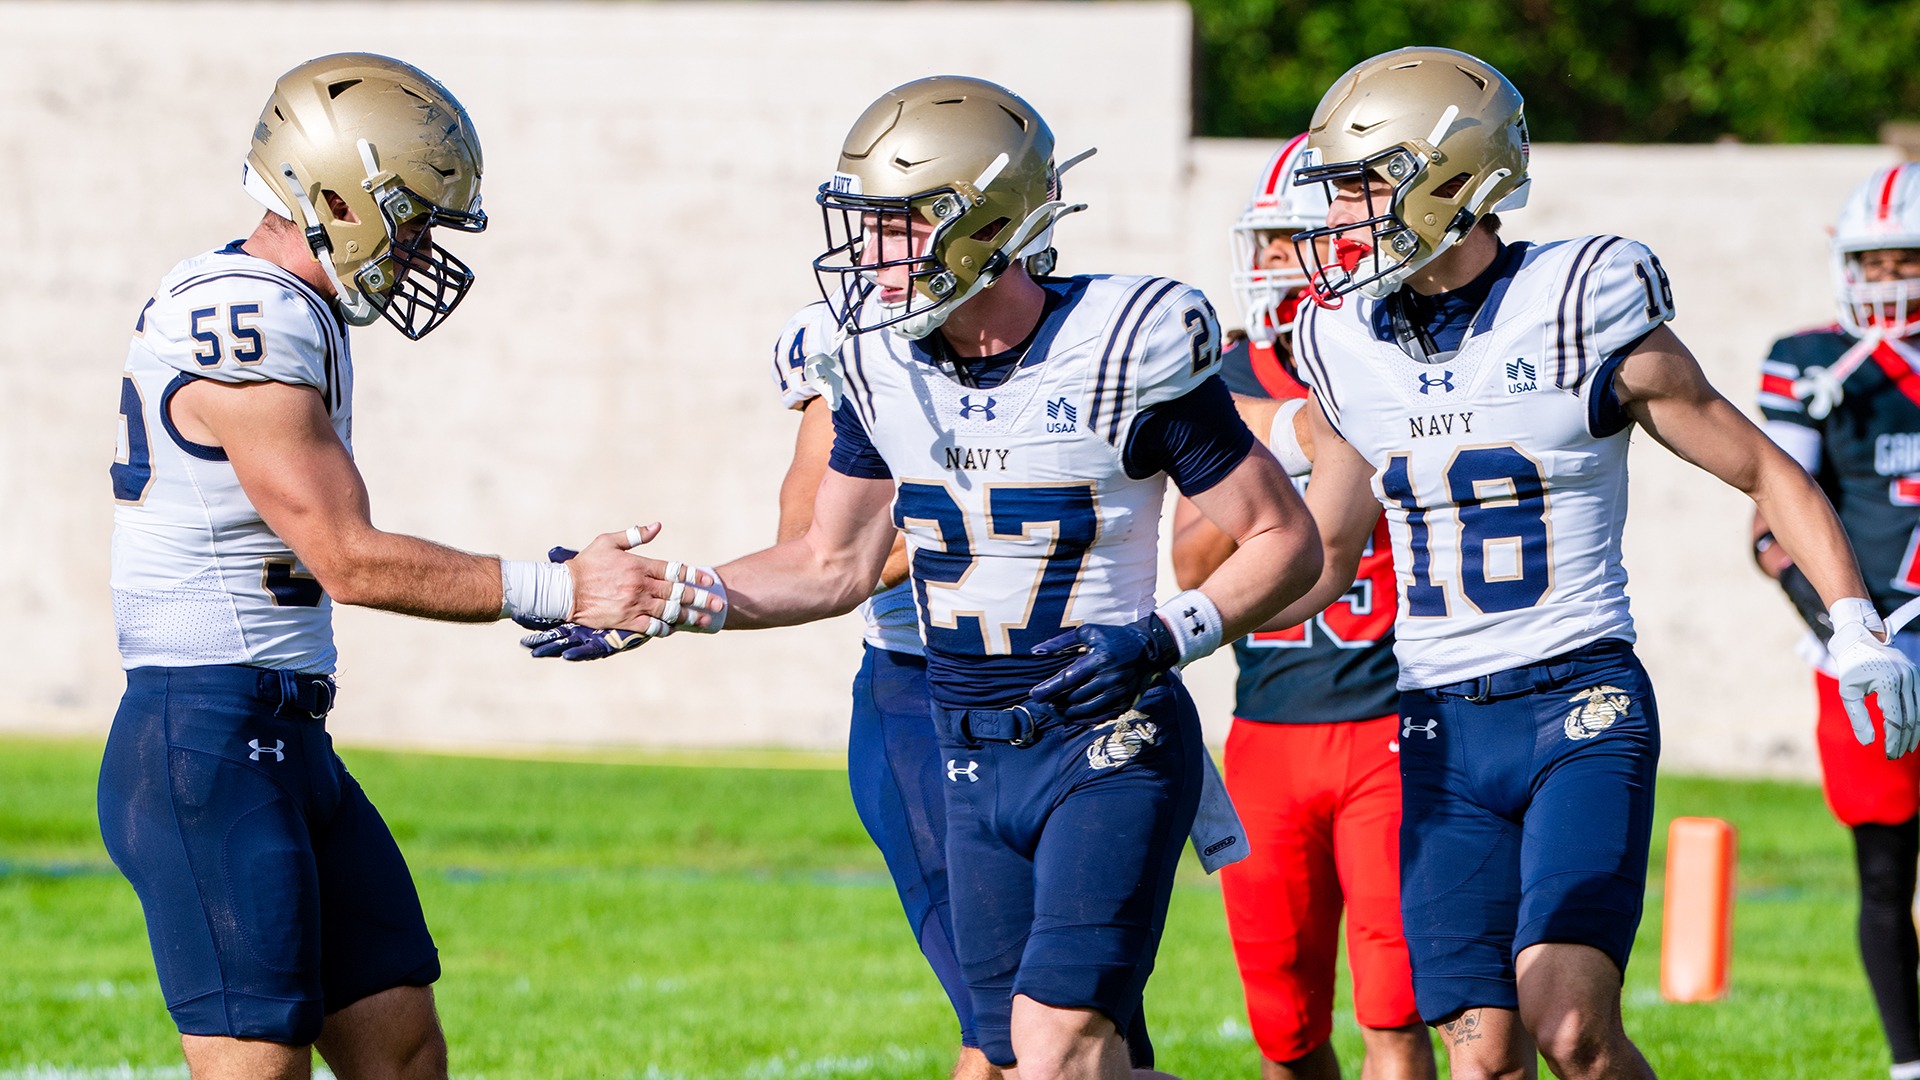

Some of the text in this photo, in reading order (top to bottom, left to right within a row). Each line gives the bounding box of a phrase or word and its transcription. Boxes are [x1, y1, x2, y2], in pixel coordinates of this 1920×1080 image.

[188, 301, 268, 370] 55
[774, 323, 810, 396] 14
[1507, 381, 1538, 394] USAA
[1046, 422, 1077, 433] USAA
[1409, 411, 1473, 438] NAVY
[945, 447, 1010, 472] NAVY
[1379, 441, 1555, 620] 18
[893, 477, 1104, 656] 27
